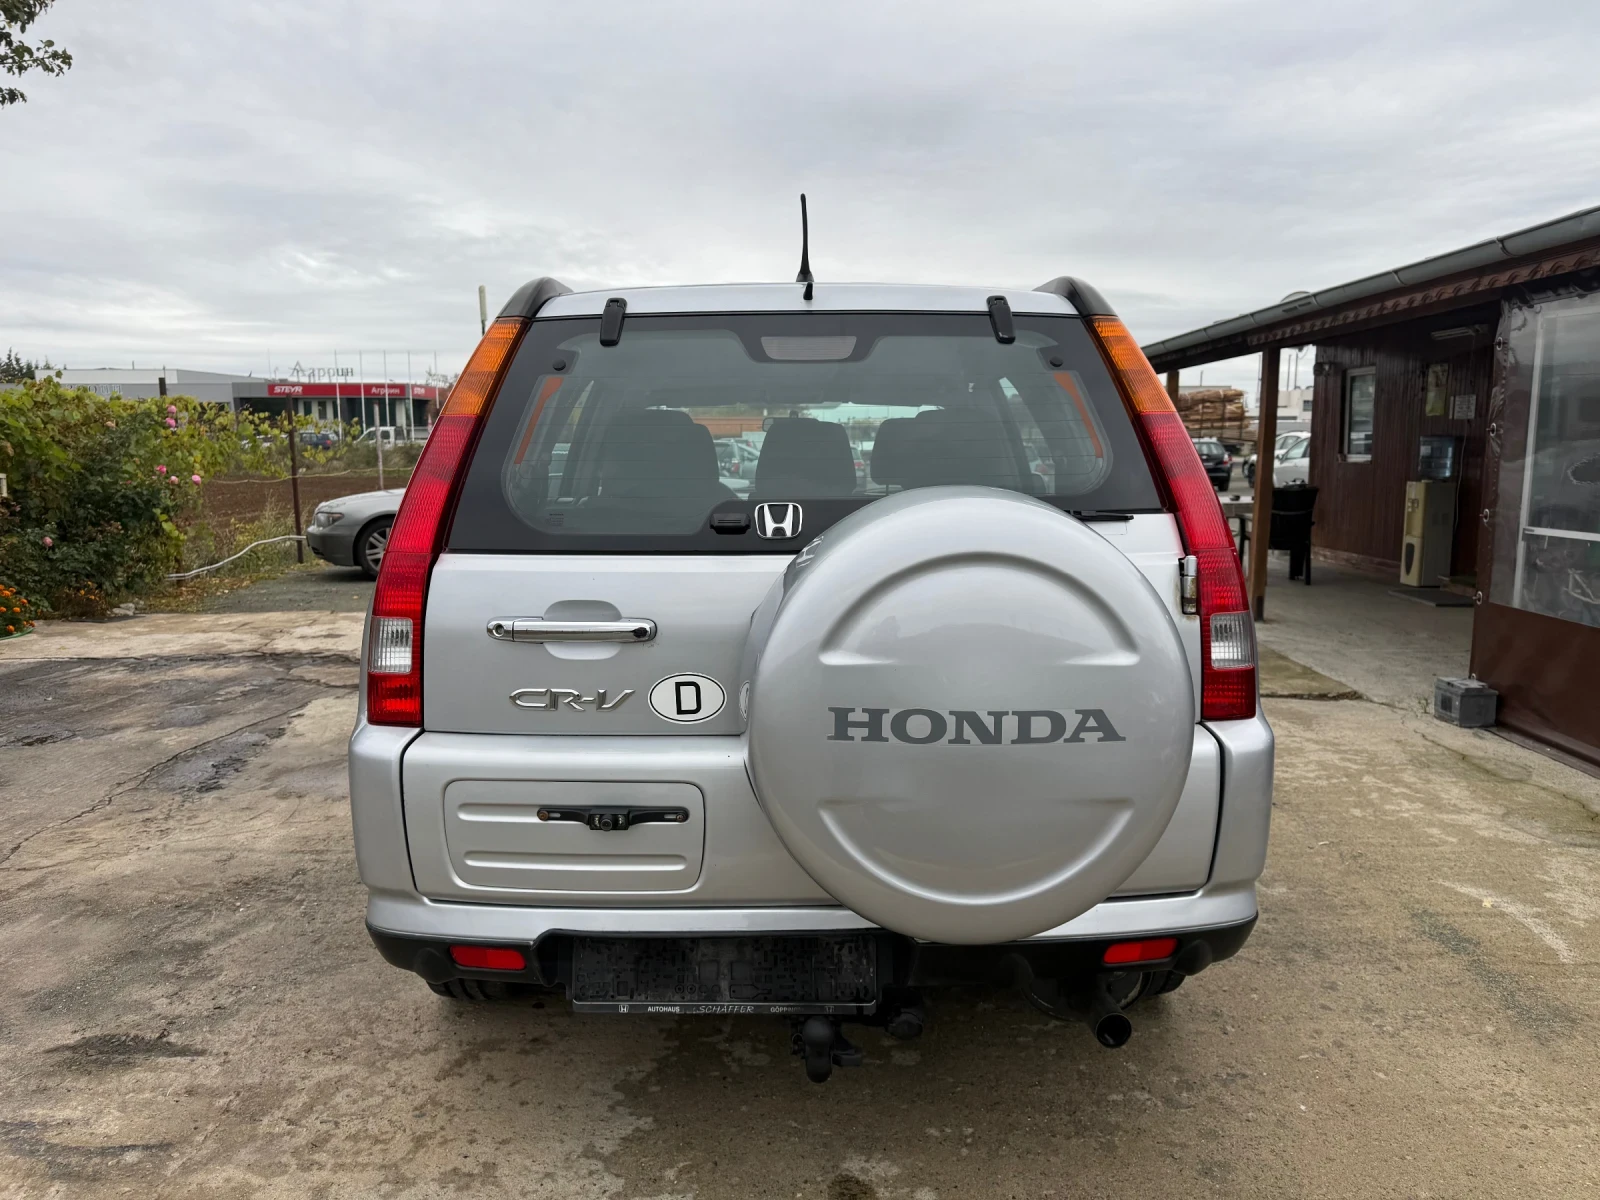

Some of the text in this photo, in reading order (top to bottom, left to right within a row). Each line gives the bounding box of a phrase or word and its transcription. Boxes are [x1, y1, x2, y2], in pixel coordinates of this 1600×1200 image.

[273, 385, 303, 394] STEYR
[509, 688, 636, 712] CR-V
[675, 680, 702, 715] D
[826, 706, 1126, 745] HONDA
